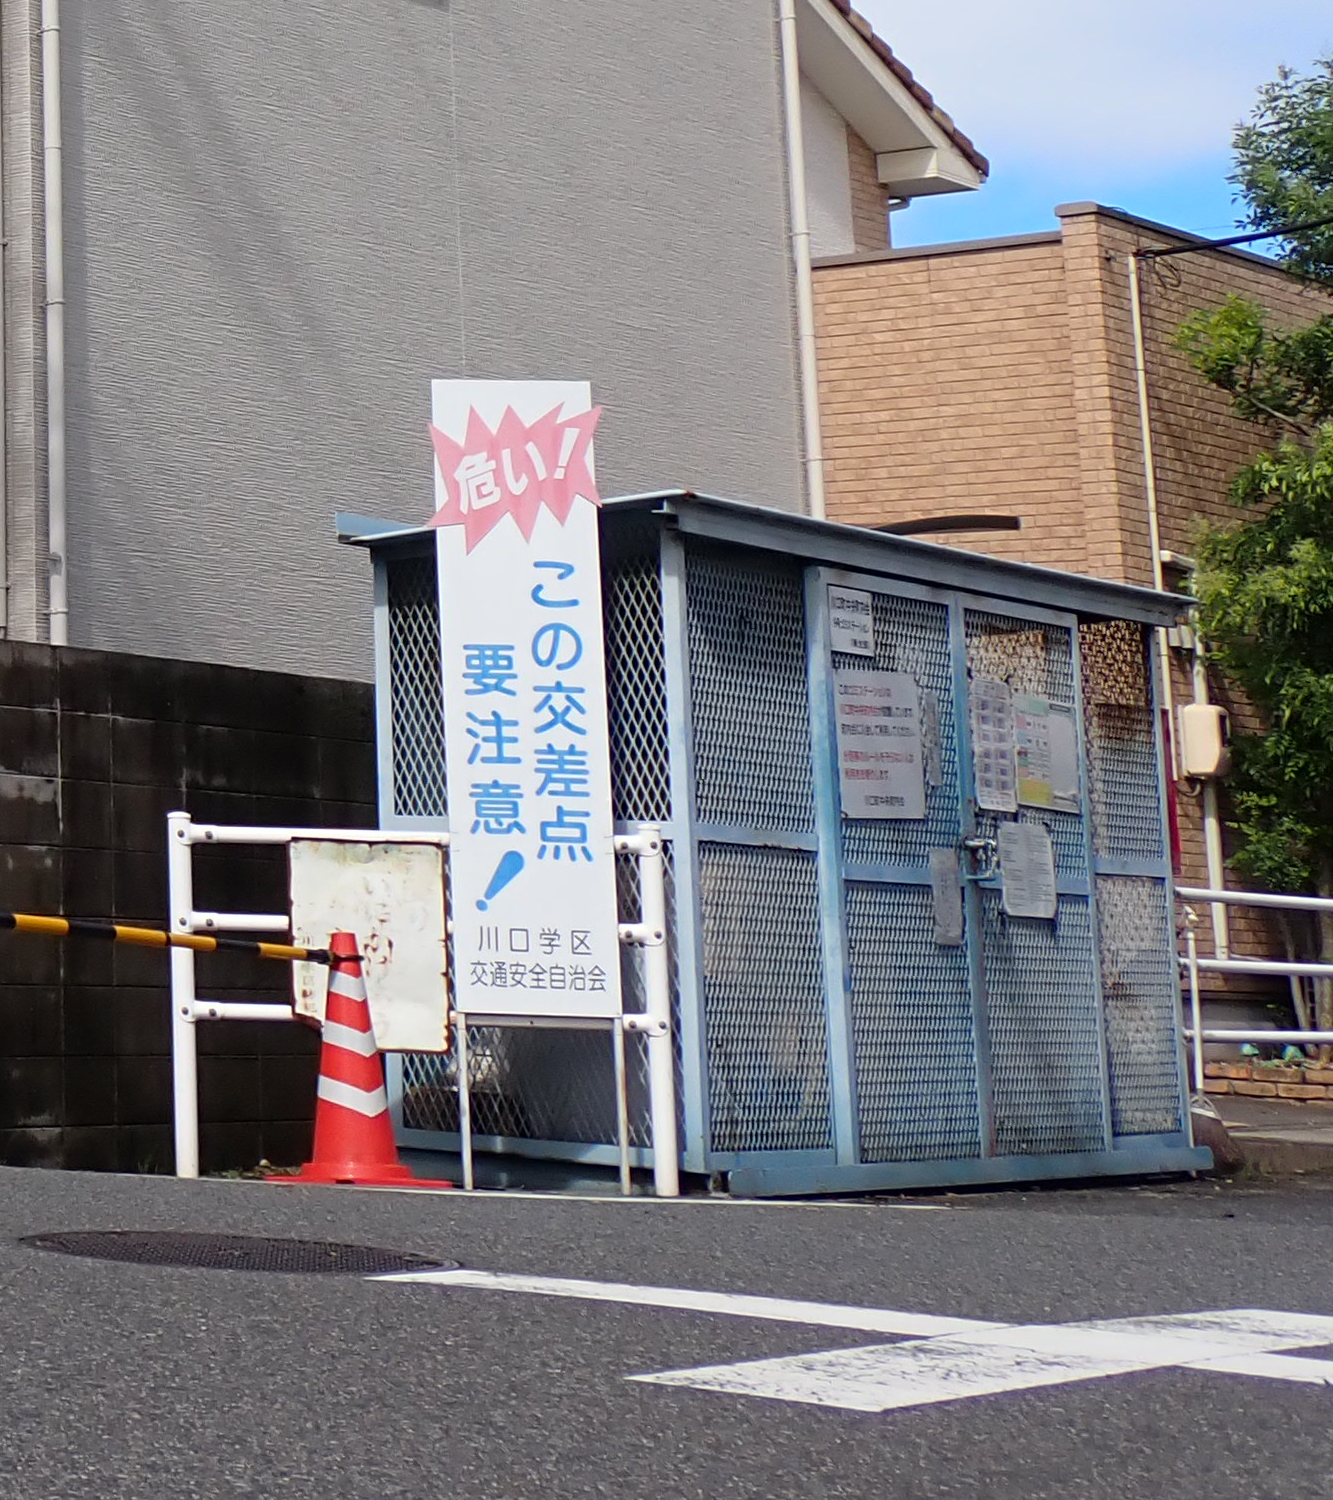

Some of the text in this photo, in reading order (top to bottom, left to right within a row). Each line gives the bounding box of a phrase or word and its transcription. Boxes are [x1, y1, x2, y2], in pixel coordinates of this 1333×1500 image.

[531, 560, 594, 863] この交差点
[477, 926, 593, 956] 川口学区
[470, 959, 608, 992] 交通安全自治会
